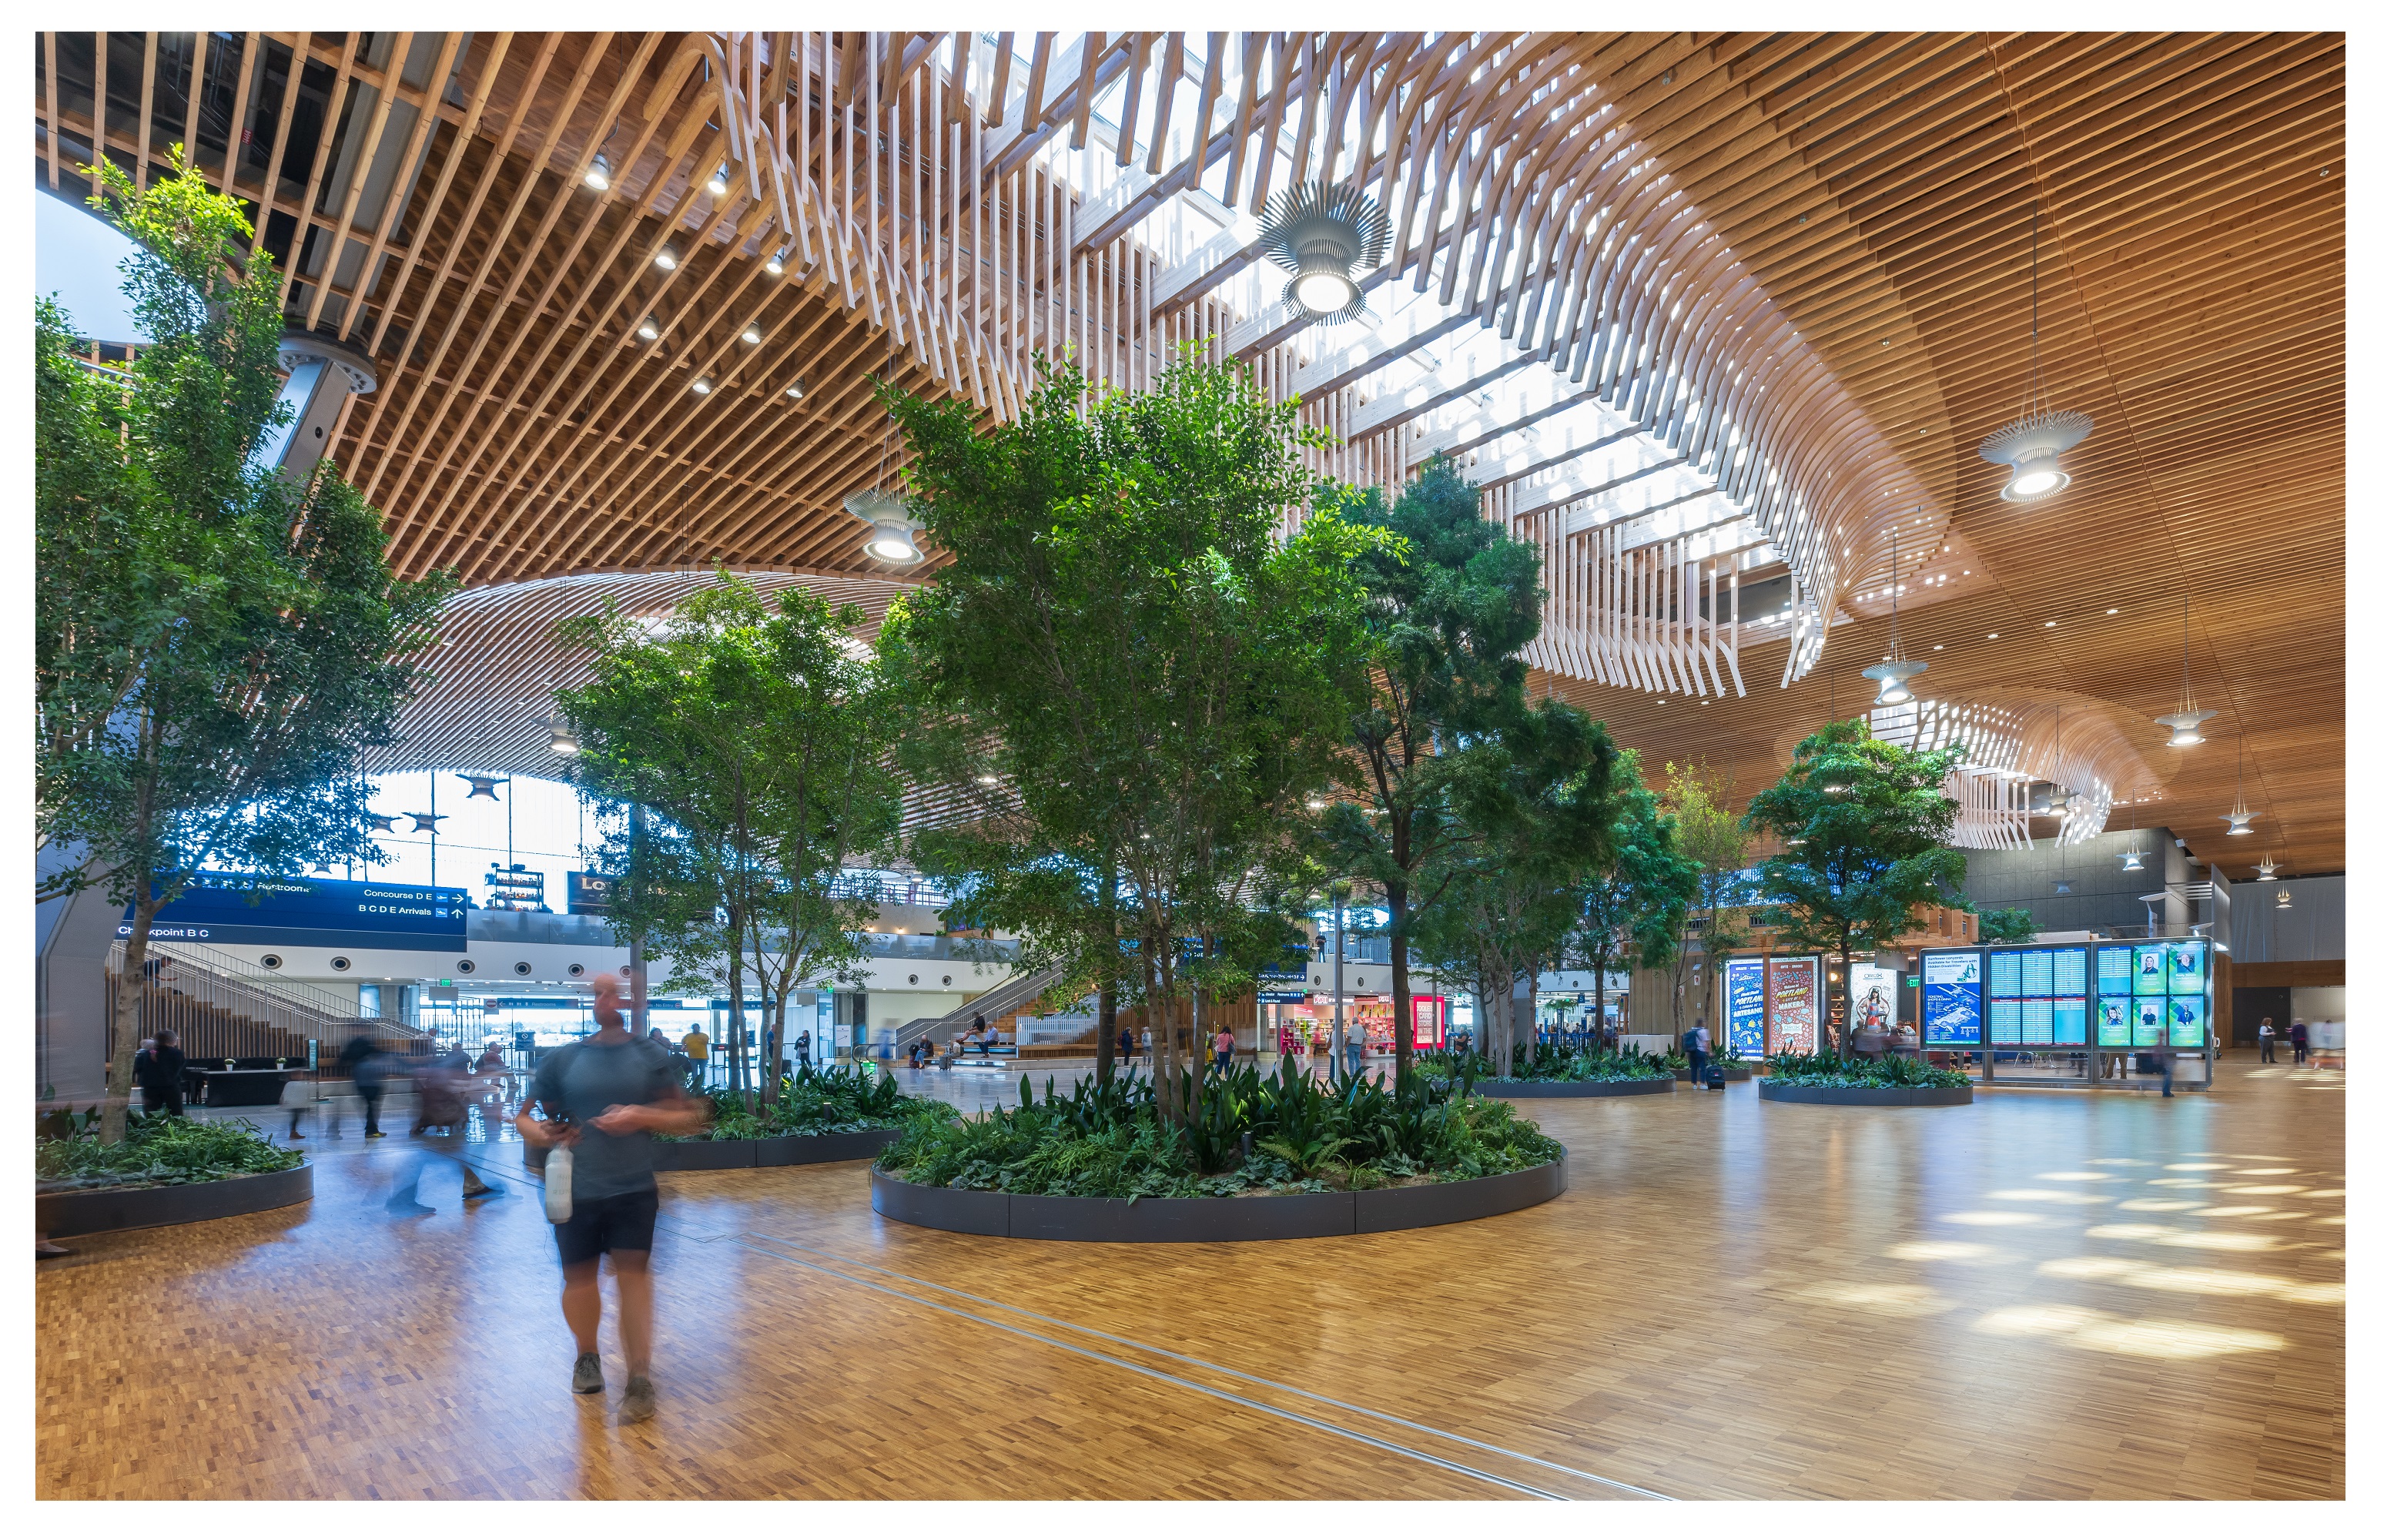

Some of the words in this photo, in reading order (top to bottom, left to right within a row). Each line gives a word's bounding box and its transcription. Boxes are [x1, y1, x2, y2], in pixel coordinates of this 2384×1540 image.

[363, 889, 414, 899] Concourse
[398, 907, 432, 916] Arrivals
[118, 926, 184, 938] Chkpoint
[187, 929, 196, 937] B
[199, 929, 209, 938] C
[1910, 979, 1920, 987] EXIT
[1776, 986, 1809, 999] PORTLAND
[1778, 1000, 1806, 1010] MAKERS
[1733, 1006, 1763, 1017] ARTESANO
